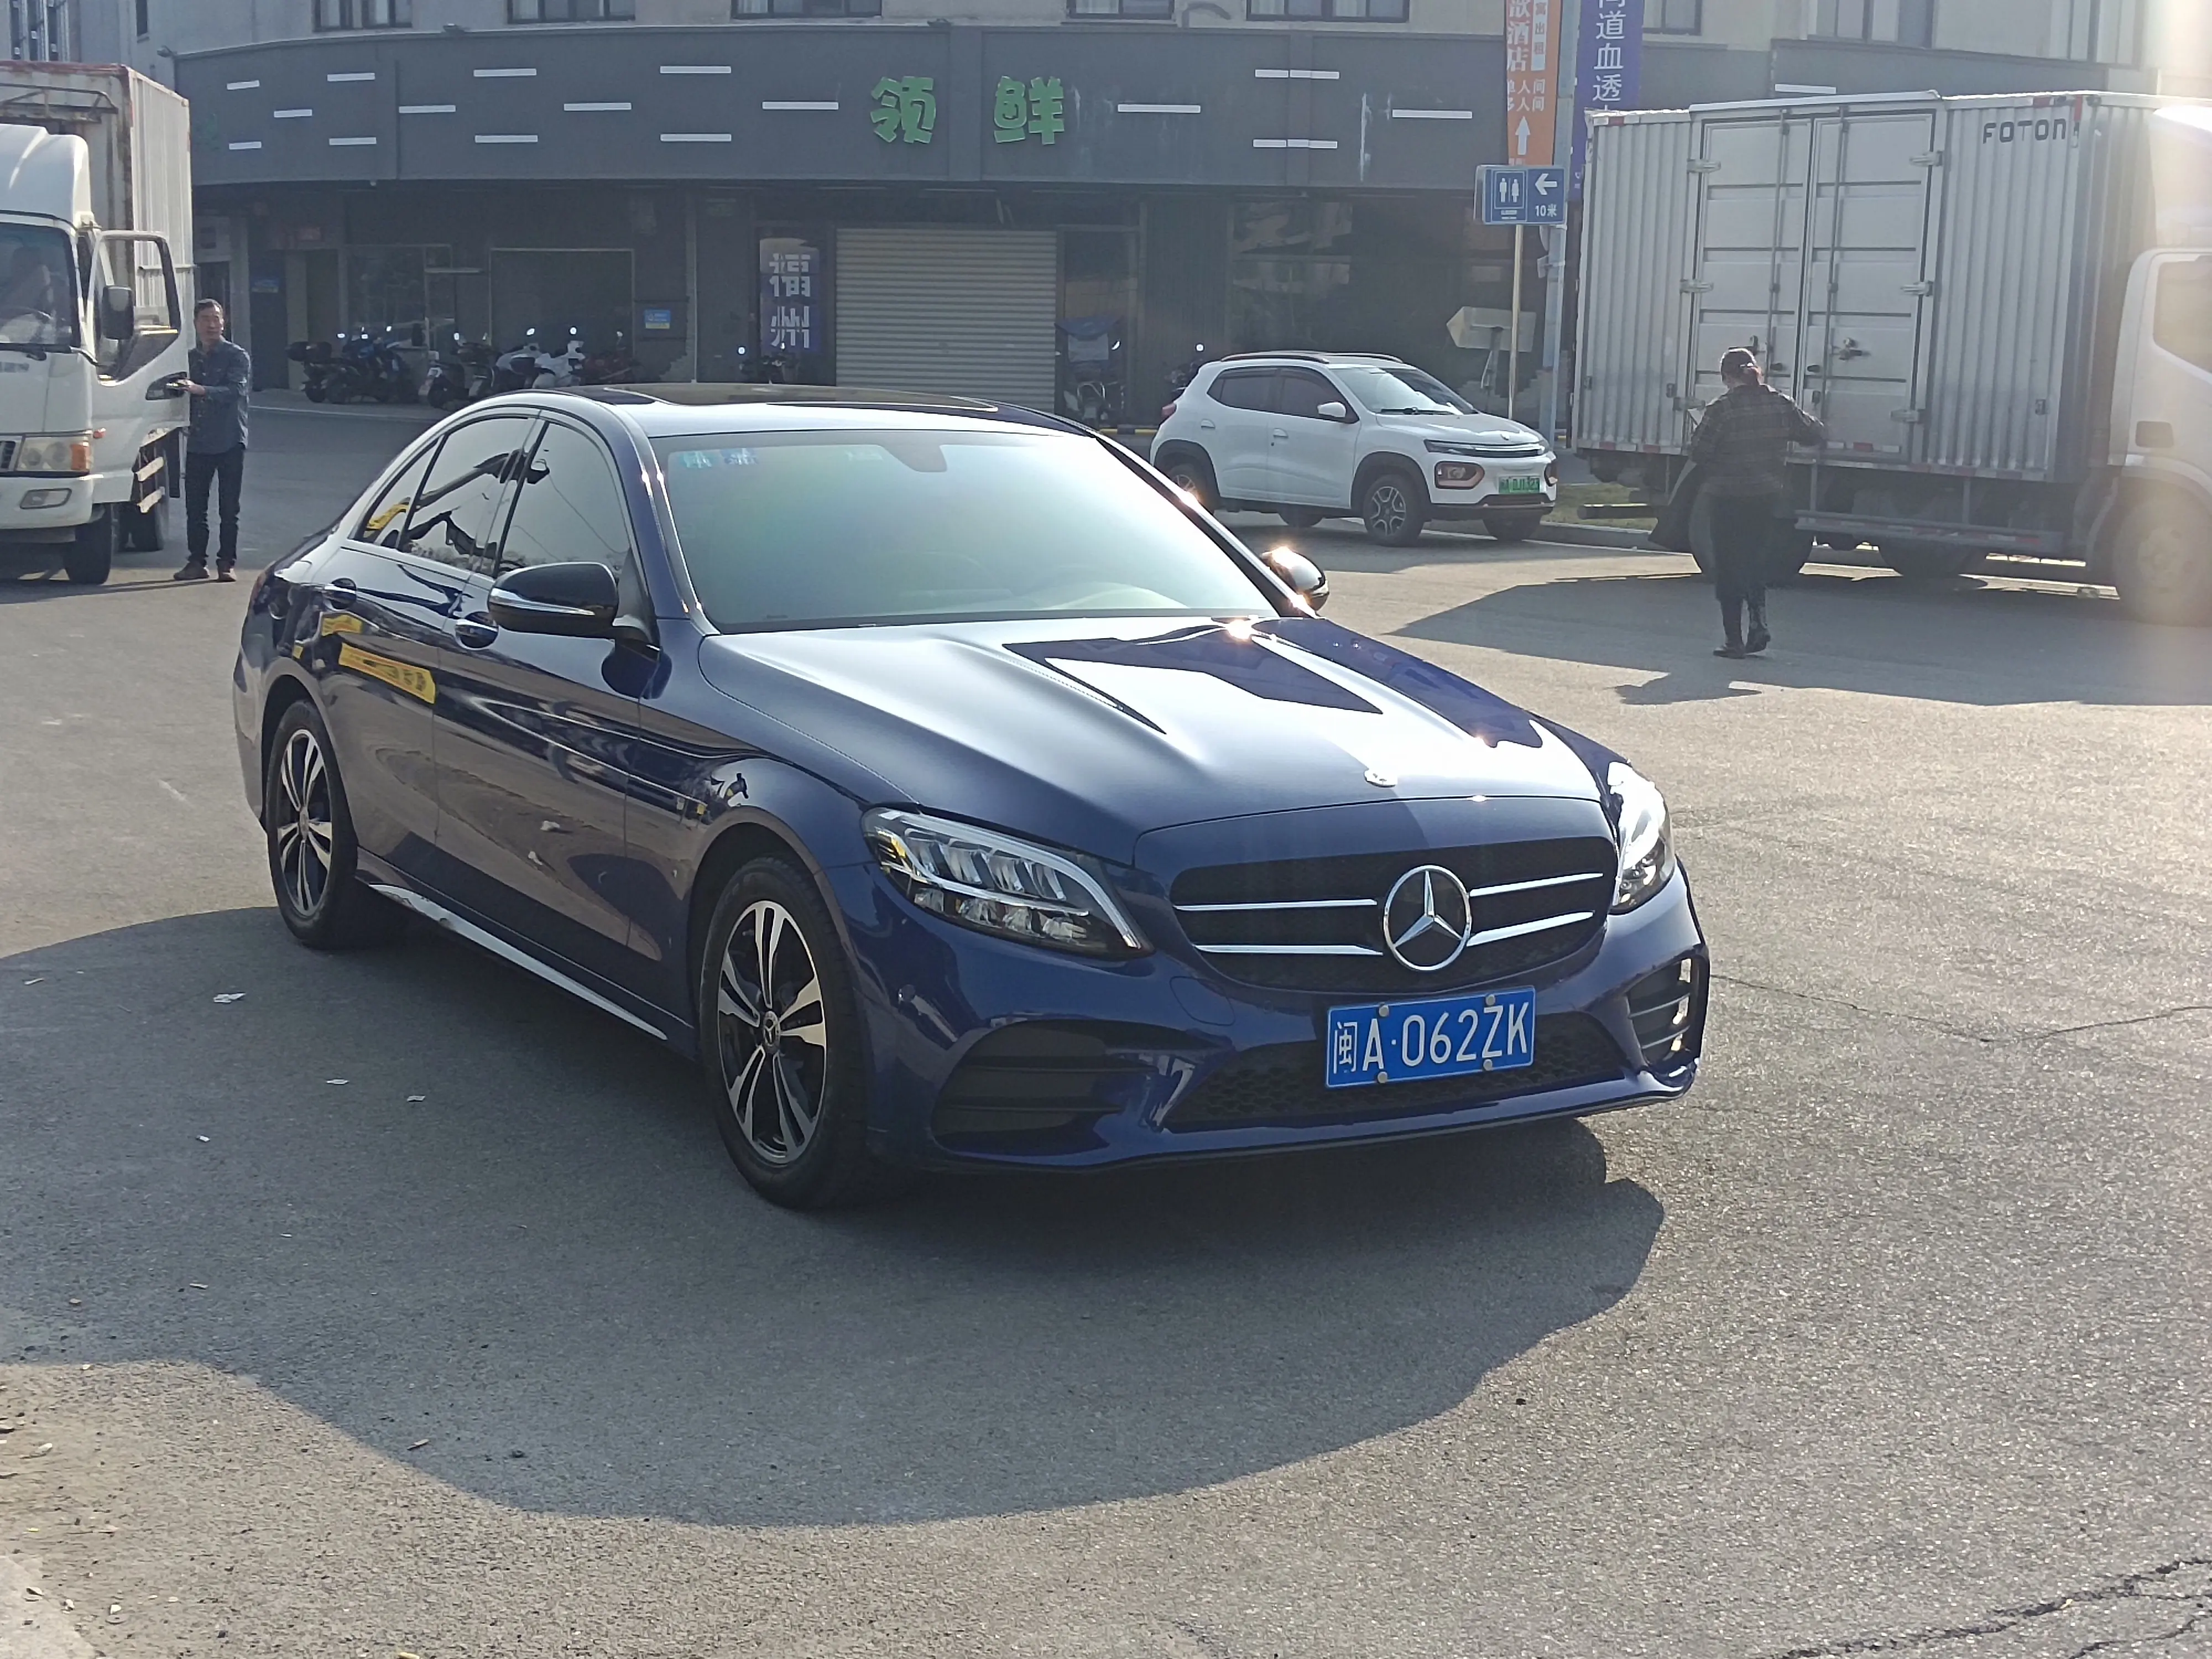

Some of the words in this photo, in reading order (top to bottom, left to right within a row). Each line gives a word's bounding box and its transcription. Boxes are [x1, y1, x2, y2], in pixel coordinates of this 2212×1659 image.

[1593, 0, 1626, 111] 道血透
[870, 76, 1065, 145] 领鲜
[1535, 204, 1557, 217] 10米
